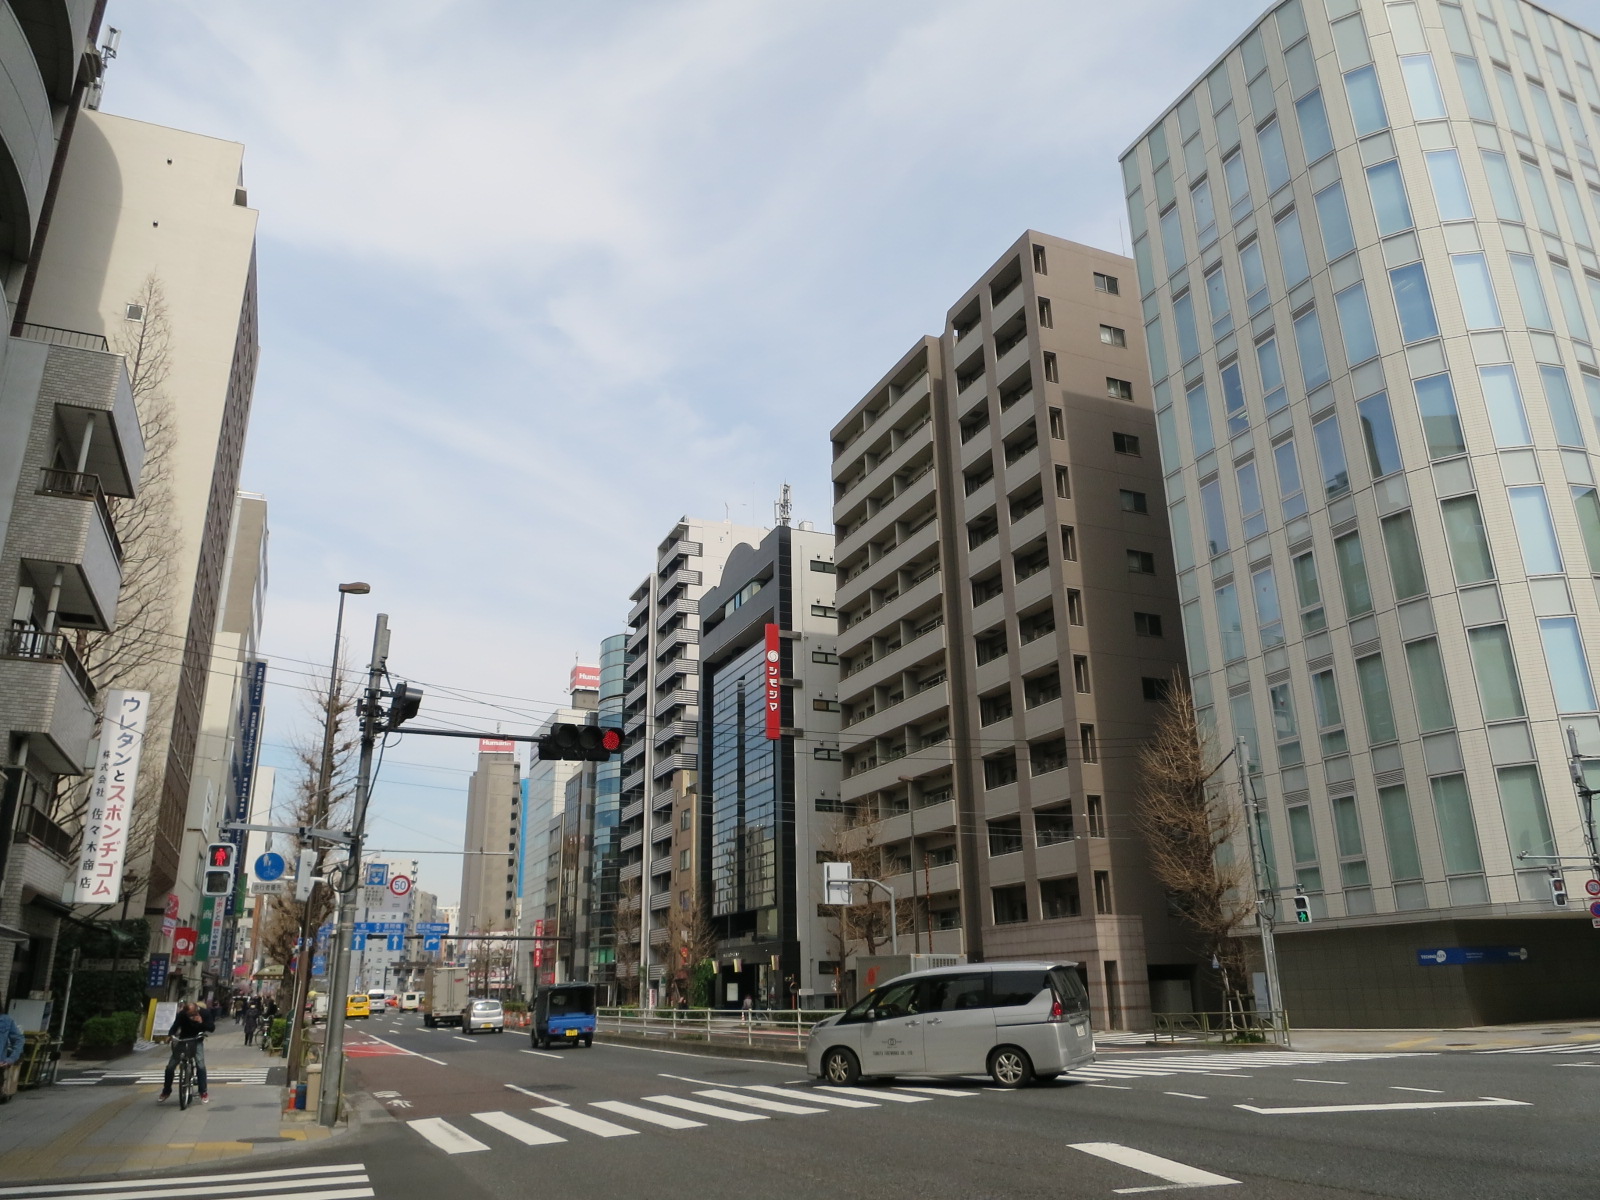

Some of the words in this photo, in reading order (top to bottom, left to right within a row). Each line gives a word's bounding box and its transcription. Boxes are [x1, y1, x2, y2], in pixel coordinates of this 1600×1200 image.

[768, 666, 778, 712] シモジマ
[92, 697, 141, 896] ウレタンとスポンヂゴム
[394, 880, 407, 891] 50
